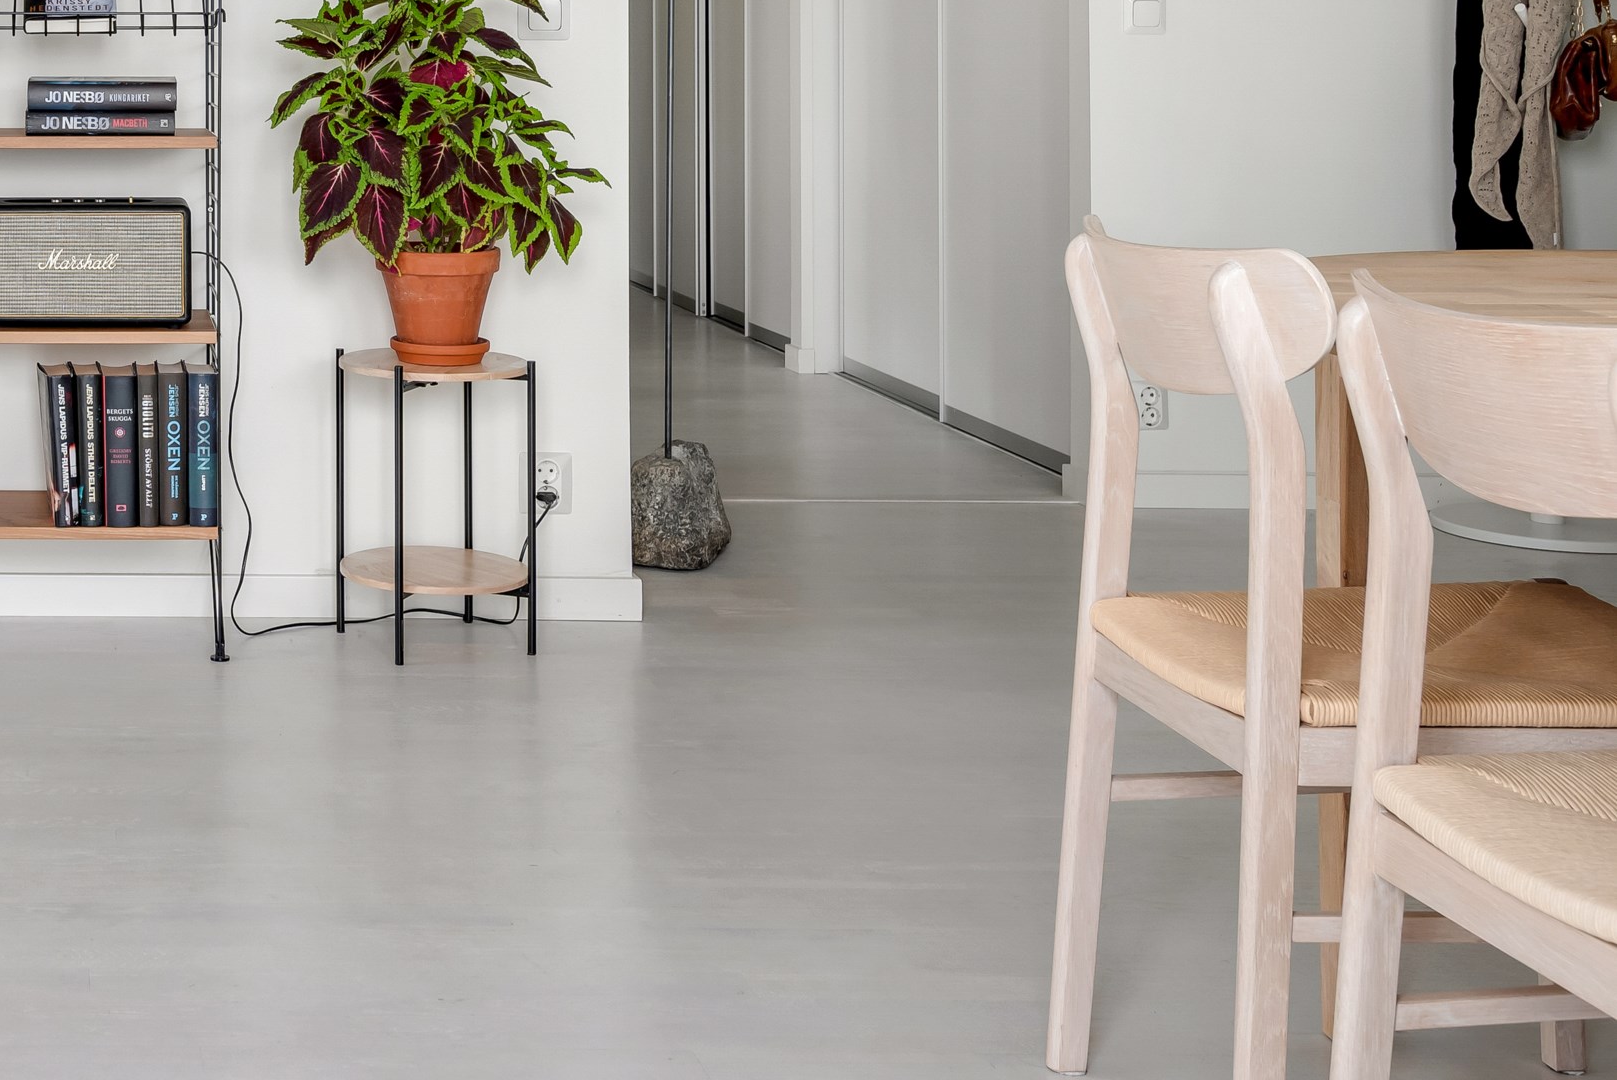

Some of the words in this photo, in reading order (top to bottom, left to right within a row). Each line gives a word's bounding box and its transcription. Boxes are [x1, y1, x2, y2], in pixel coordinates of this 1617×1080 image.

[45, 91, 62, 103] JO
[63, 91, 105, 103] NESBØ
[109, 94, 150, 103] KUNGARIKET
[41, 116, 60, 130] JO
[61, 116, 110, 130] NESBØ
[112, 118, 148, 128] MACBETH
[38, 248, 120, 270] Marshall
[57, 384, 66, 406] JENS
[86, 383, 94, 405] JENS
[168, 384, 176, 418] JENSEN
[58, 406, 67, 440] LAPIDUS
[142, 400, 154, 438] GIOLITO
[87, 442, 95, 470] STHLM
[167, 420, 181, 471] OXEN
[197, 420, 211, 470] OXEN
[60, 442, 70, 493] VIP-RUMMET
[144, 448, 153, 478] STÖRST
[145, 478, 152, 489] AV
[145, 488, 153, 508] ALLT
